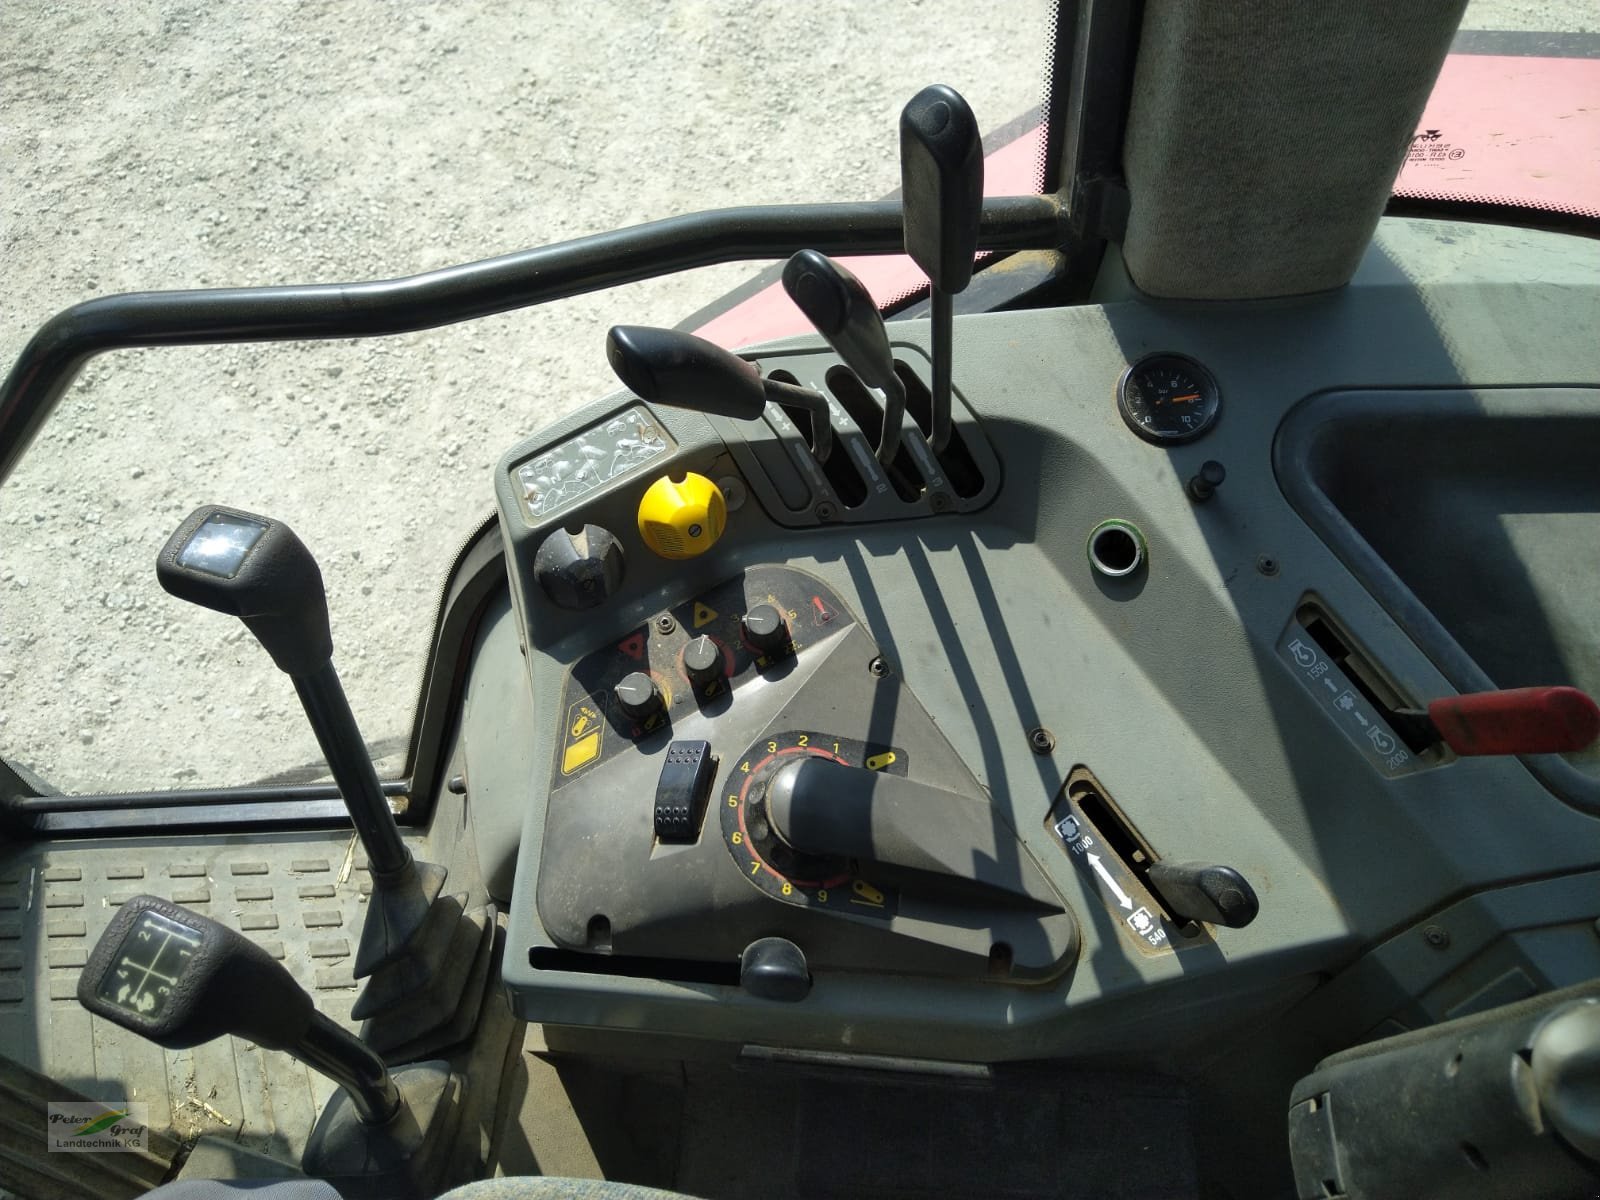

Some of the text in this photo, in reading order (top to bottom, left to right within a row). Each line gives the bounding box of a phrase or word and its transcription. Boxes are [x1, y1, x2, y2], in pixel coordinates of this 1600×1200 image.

[1307, 661, 1329, 680] 1550
[799, 735, 808, 746] 2
[767, 741, 777, 753] 3
[833, 743, 840, 753] 1
[1387, 750, 1408, 769] 2000
[740, 761, 750, 773] 4
[728, 795, 738, 807] 5
[732, 831, 742, 844] 6
[1071, 835, 1094, 855] 1000
[751, 861, 761, 874] 7
[781, 882, 792, 895] 8
[818, 890, 828, 902] 9
[138, 930, 151, 941] 2
[1148, 928, 1166, 945] 540
[116, 969, 129, 978] 4
[158, 985, 170, 996] 3
